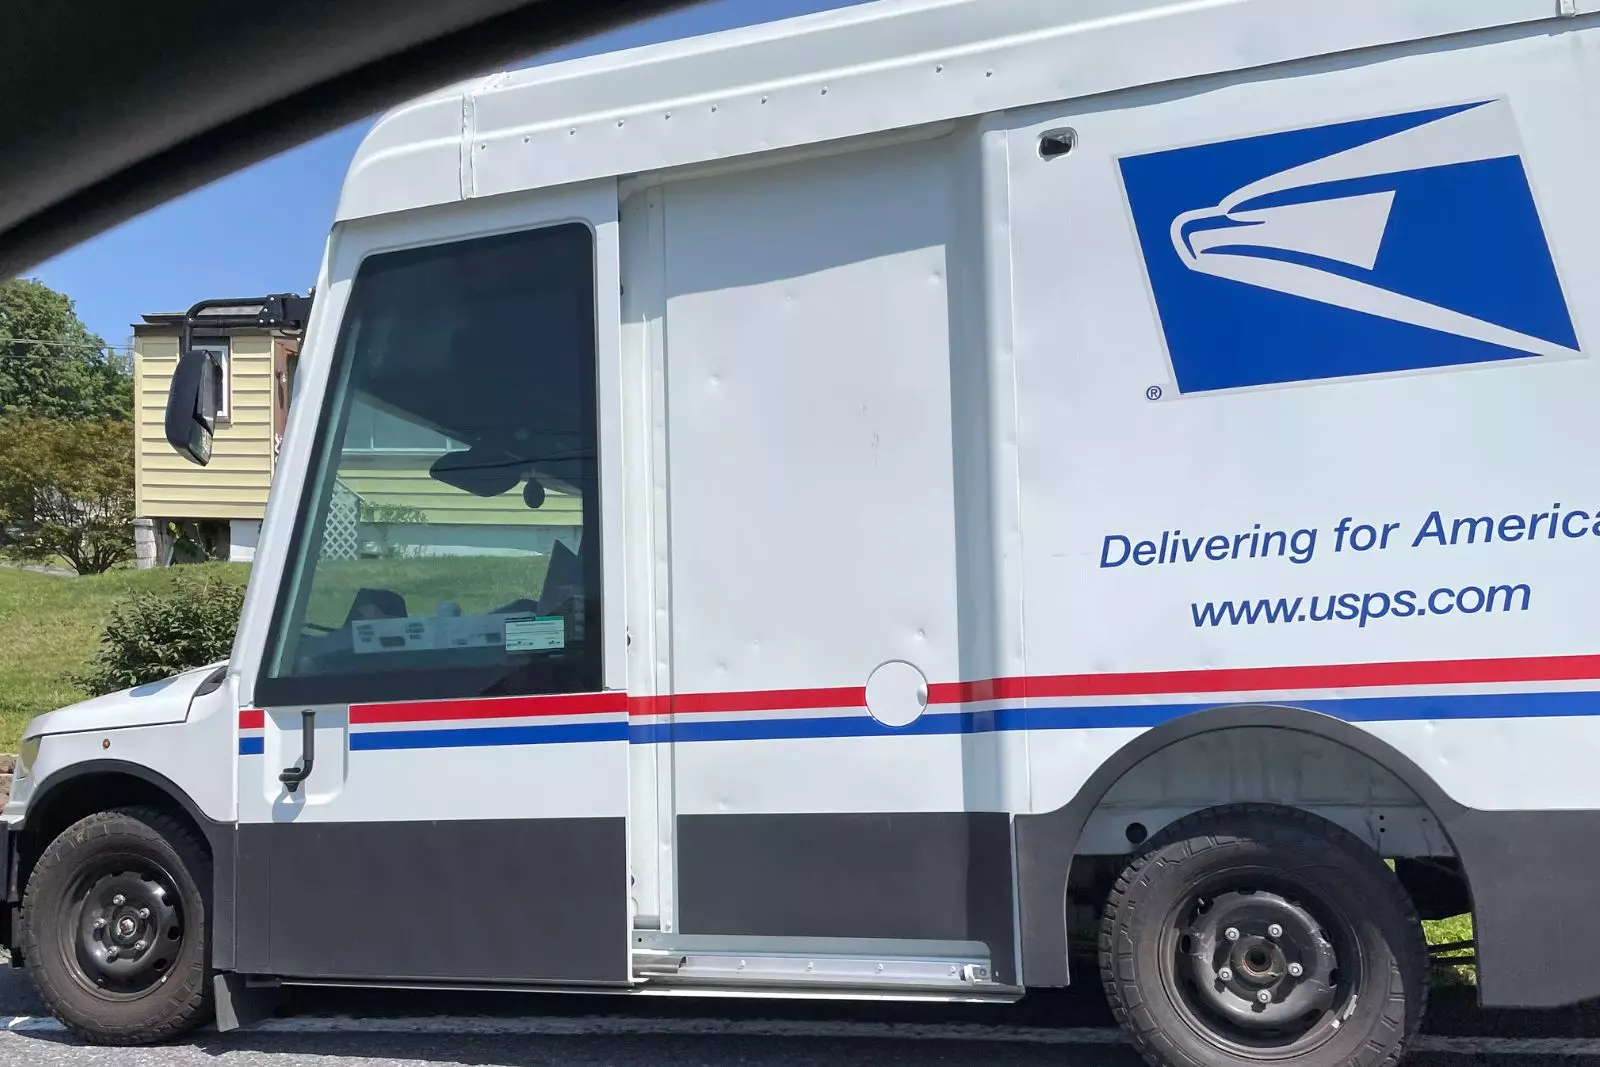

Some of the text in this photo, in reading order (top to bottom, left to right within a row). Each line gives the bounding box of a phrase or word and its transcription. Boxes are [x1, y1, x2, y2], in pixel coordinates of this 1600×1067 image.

[1099, 523, 1317, 569] Delivering
[1334, 516, 1400, 553] for
[1191, 584, 1531, 628] www.usps.com
